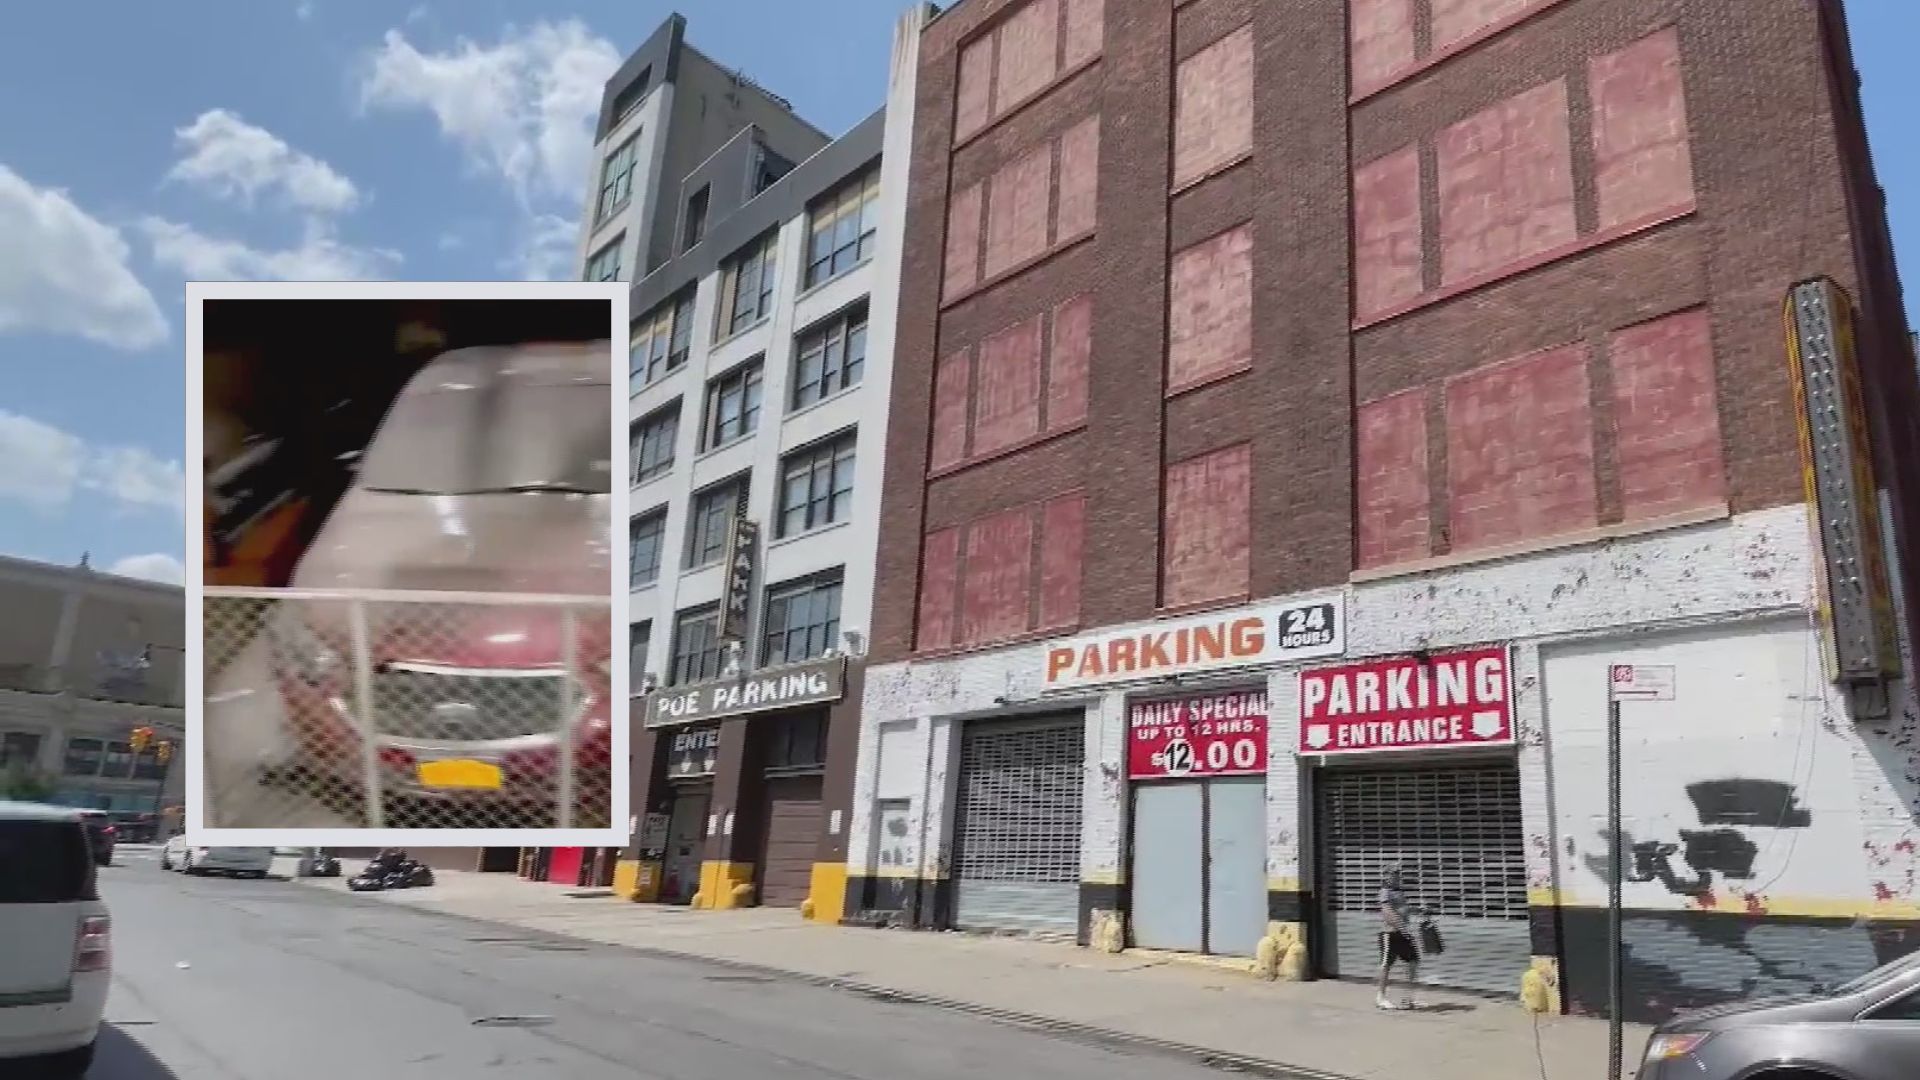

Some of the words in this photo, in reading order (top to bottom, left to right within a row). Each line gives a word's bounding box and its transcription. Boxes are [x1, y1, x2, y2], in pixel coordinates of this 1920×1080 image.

[1287, 607, 1325, 633] 24
[1046, 616, 1265, 683] PARKING
[1281, 630, 1331, 648] HOURS
[657, 691, 700, 717] POE
[711, 671, 828, 711] PARKING
[1303, 657, 1504, 718] PARKING
[1131, 702, 1183, 728] DAILY
[1189, 693, 1269, 723] SPECIAL
[674, 729, 720, 752] ENTE
[1137, 728, 1160, 740] UP
[1164, 725, 1186, 738] TO
[1192, 723, 1212, 737] 12
[1216, 719, 1262, 735] HRS.
[1336, 715, 1463, 747] ENTRANCE
